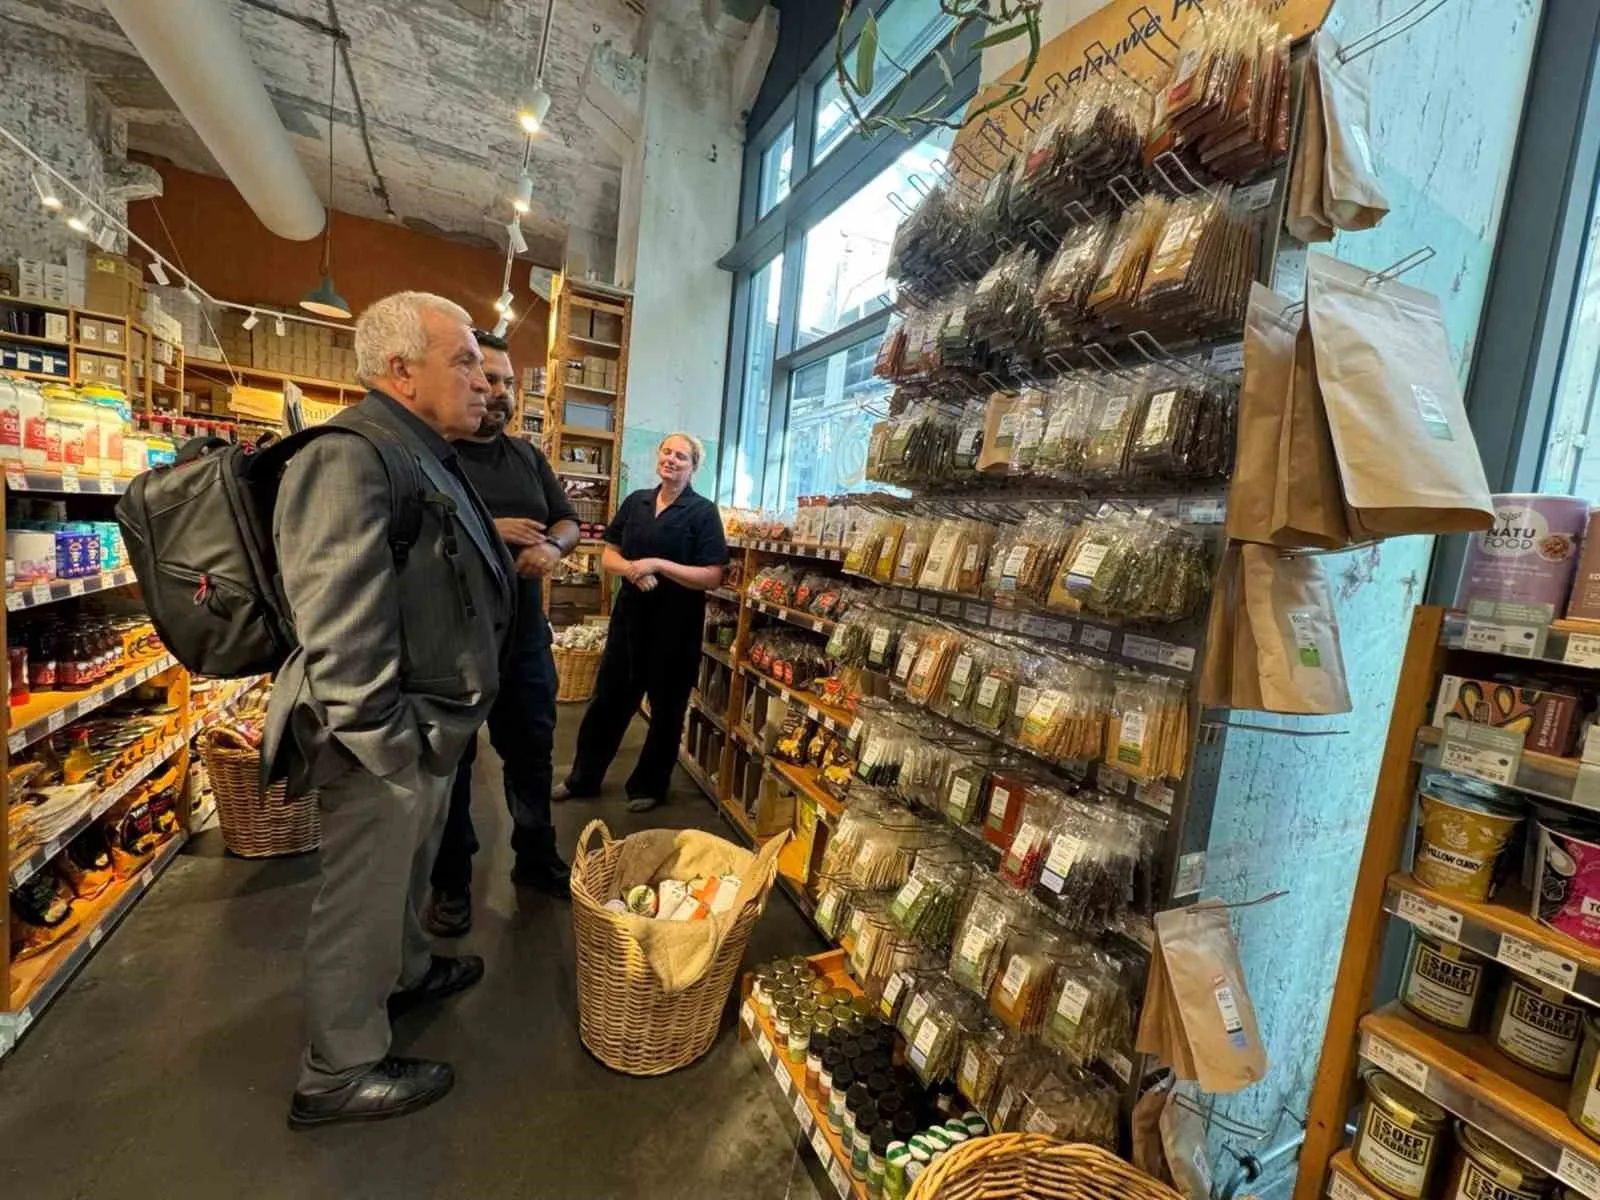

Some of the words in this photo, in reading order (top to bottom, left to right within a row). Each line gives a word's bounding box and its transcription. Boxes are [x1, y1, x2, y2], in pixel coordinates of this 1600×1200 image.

[1484, 538, 1534, 550] FOOD
[1487, 527, 1537, 539] NATU
[1431, 956, 1472, 981] SOEP
[1527, 998, 1576, 1025] SOEP
[1382, 1120, 1423, 1149] SOEP
